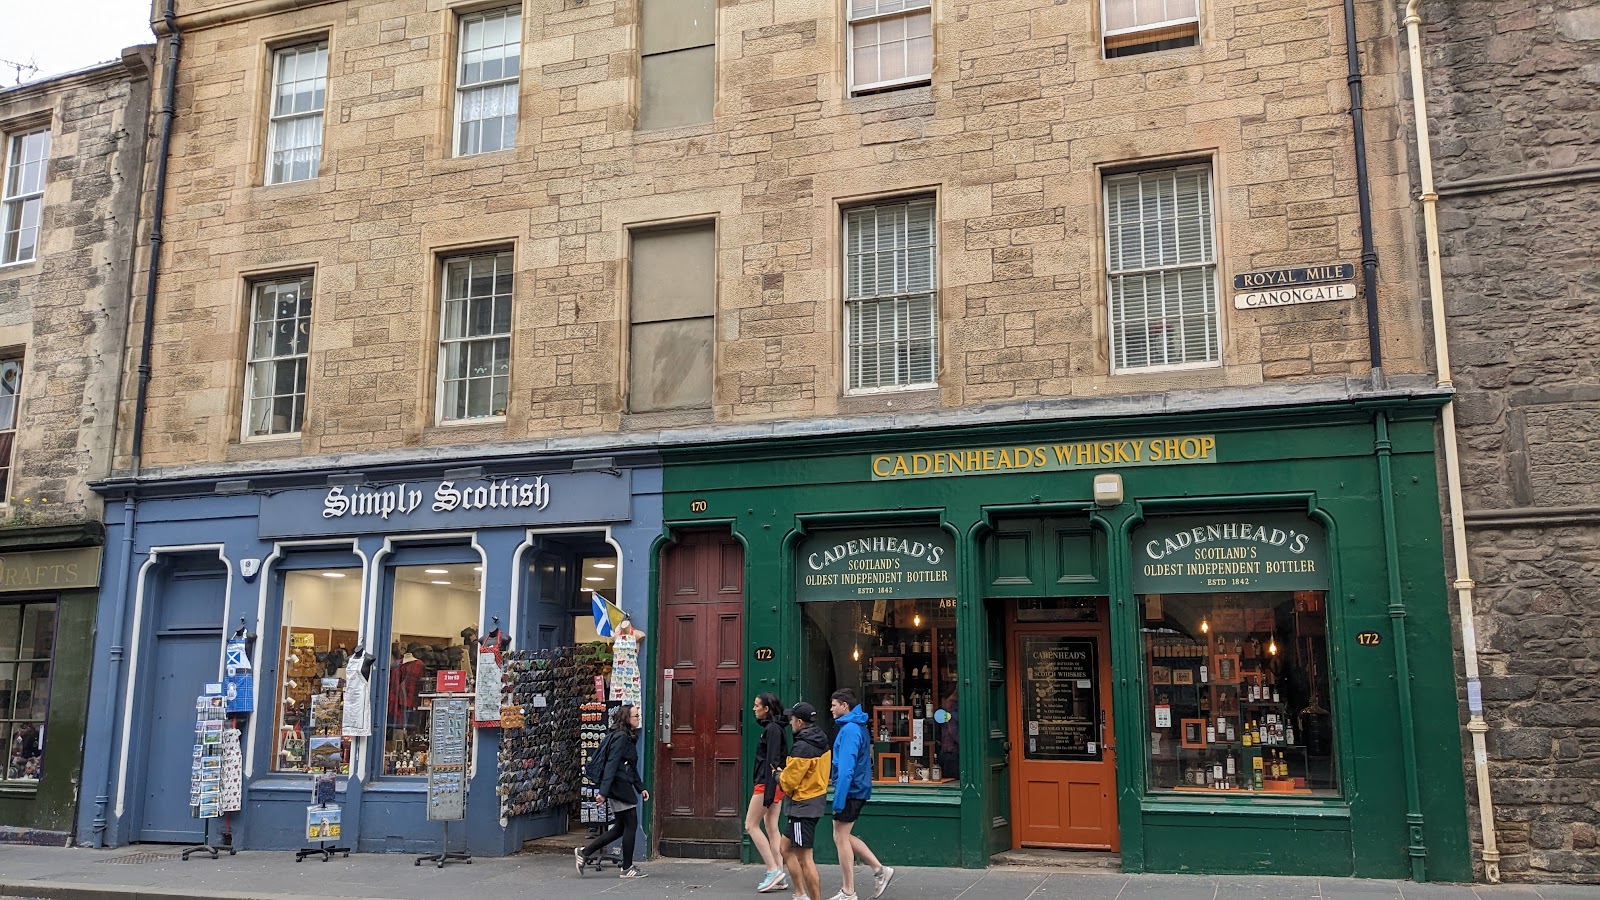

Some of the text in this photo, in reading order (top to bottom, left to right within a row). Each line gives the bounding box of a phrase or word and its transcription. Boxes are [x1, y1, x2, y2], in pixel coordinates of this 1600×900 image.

[1244, 265, 1344, 287] ROYAL MILE
[1246, 285, 1345, 307] CANONGATE
[872, 435, 1216, 477] CADENHEADS WHISKY SHOP
[322, 475, 550, 520] Simply Scottish
[690, 500, 707, 512] 170
[1145, 523, 1310, 560] CADENHEAD'S
[808, 536, 945, 571] CADENHEAD'S
[1194, 546, 1257, 560] SCOTLAND'S
[0, 558, 78, 586] RAFTS
[848, 558, 901, 571] SCOTLAND'S
[1144, 560, 1316, 577] OLDEST INDEPENDENT BOTTLER
[805, 570, 948, 586] OLDEST INDEPENDENT BOTTLER
[878, 586, 893, 594] 1842
[1357, 633, 1380, 645] 172
[755, 649, 772, 660] 172
